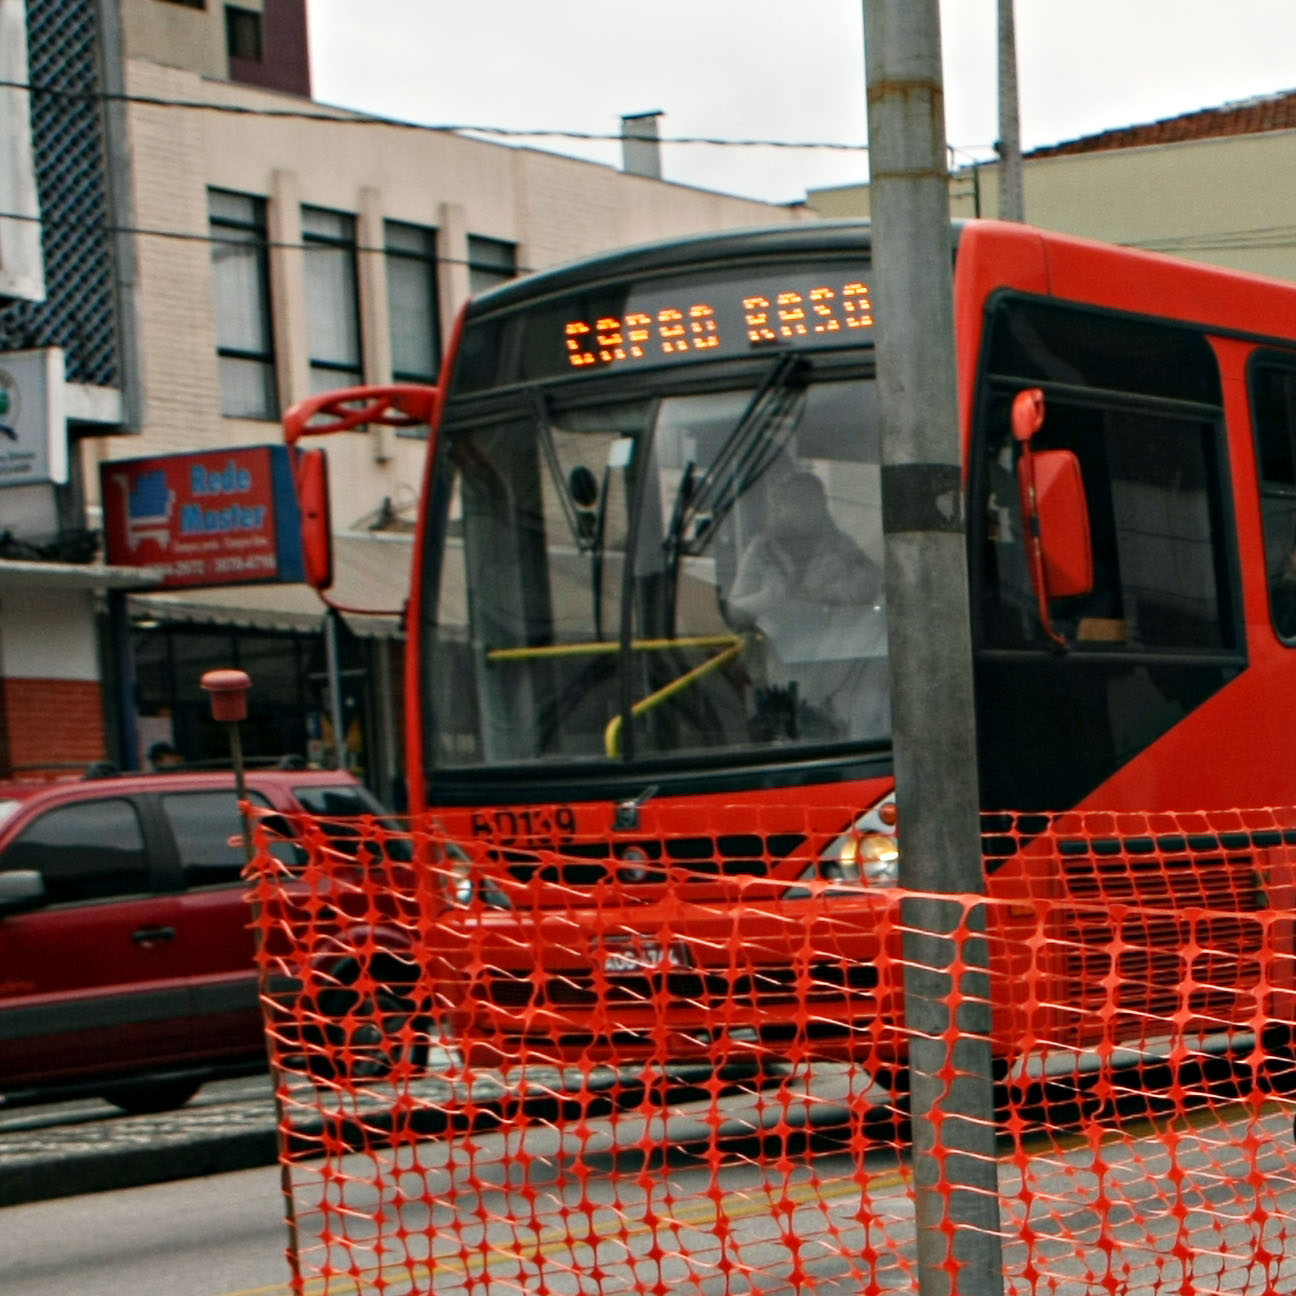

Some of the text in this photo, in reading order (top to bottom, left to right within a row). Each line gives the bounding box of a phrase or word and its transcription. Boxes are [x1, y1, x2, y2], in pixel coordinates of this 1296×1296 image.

[742, 281, 874, 342] RASO
[190, 459, 252, 496] Rede
[179, 503, 267, 536] Master
